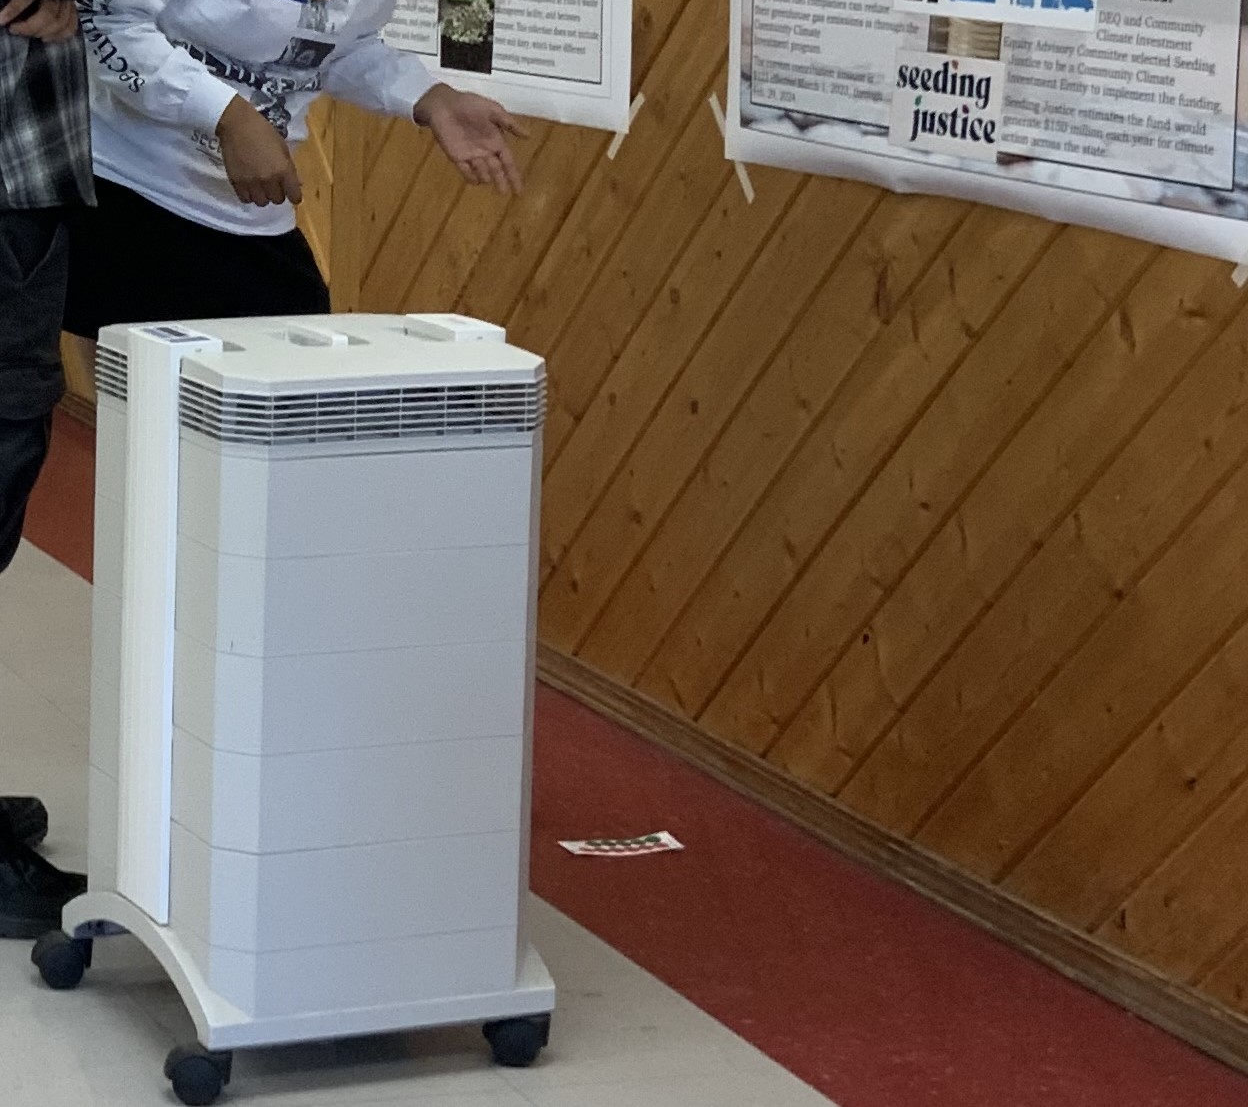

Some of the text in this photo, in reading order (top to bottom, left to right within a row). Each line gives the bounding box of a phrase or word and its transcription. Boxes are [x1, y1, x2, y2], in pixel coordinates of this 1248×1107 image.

[1096, 29, 1193, 51] Climate Investment
[1098, 11, 1205, 37] DEQ and Community
[896, 60, 992, 110] seeding
[910, 95, 996, 144] justice
